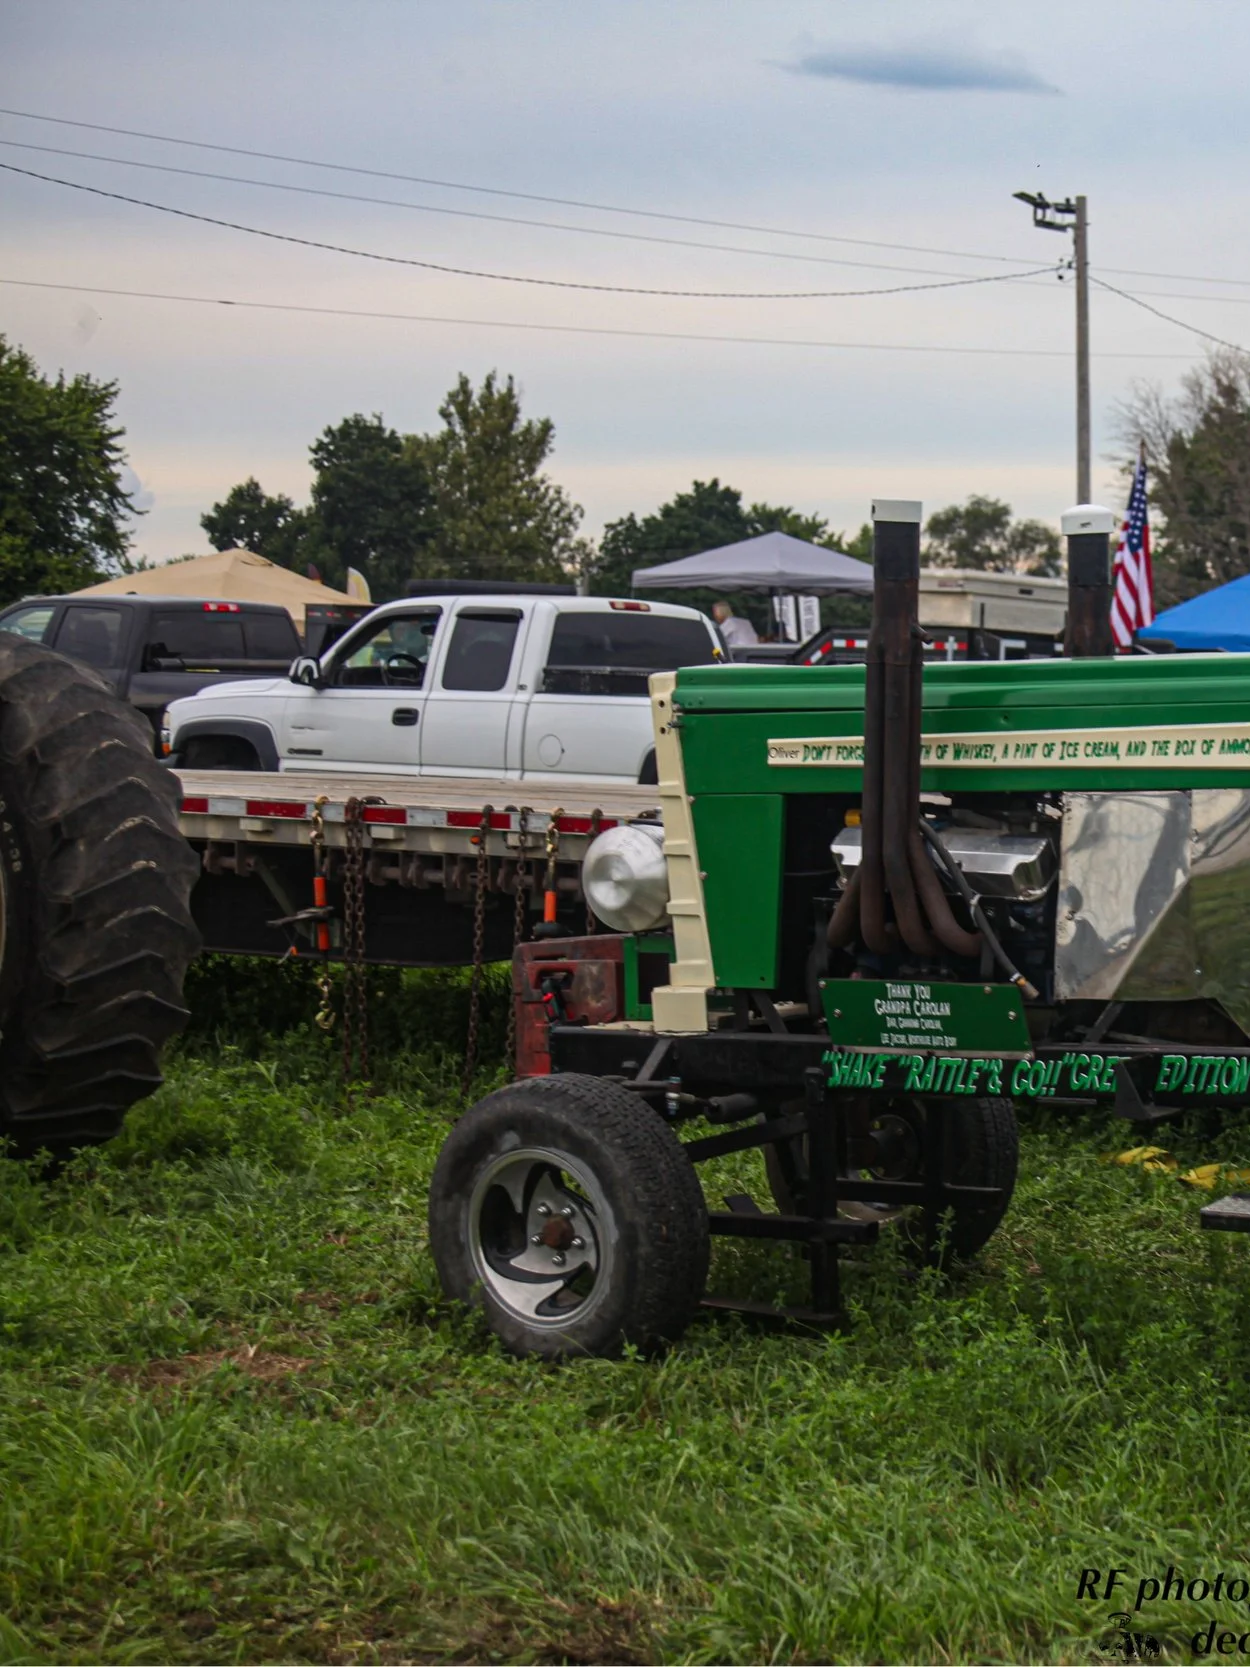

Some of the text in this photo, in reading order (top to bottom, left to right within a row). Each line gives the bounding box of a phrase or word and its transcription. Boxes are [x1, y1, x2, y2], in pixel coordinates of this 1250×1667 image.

[768, 746, 799, 760] Oliver
[835, 744, 865, 761] FORG
[935, 743, 949, 760] OF
[1013, 742, 1039, 759] PINT
[1042, 742, 1056, 758] OF
[1058, 740, 1080, 760] ICE
[1125, 740, 1147, 757] AND
[1151, 740, 1171, 756] THE
[1174, 739, 1197, 756] BOX
[1201, 739, 1215, 755] OF
[885, 983, 931, 1000] THANK YOU
[874, 998, 951, 1017] GRANDPA CAROLAN
[1011, 1059, 1063, 1096] GO!!
[1062, 1052, 1132, 1092] "GRE
